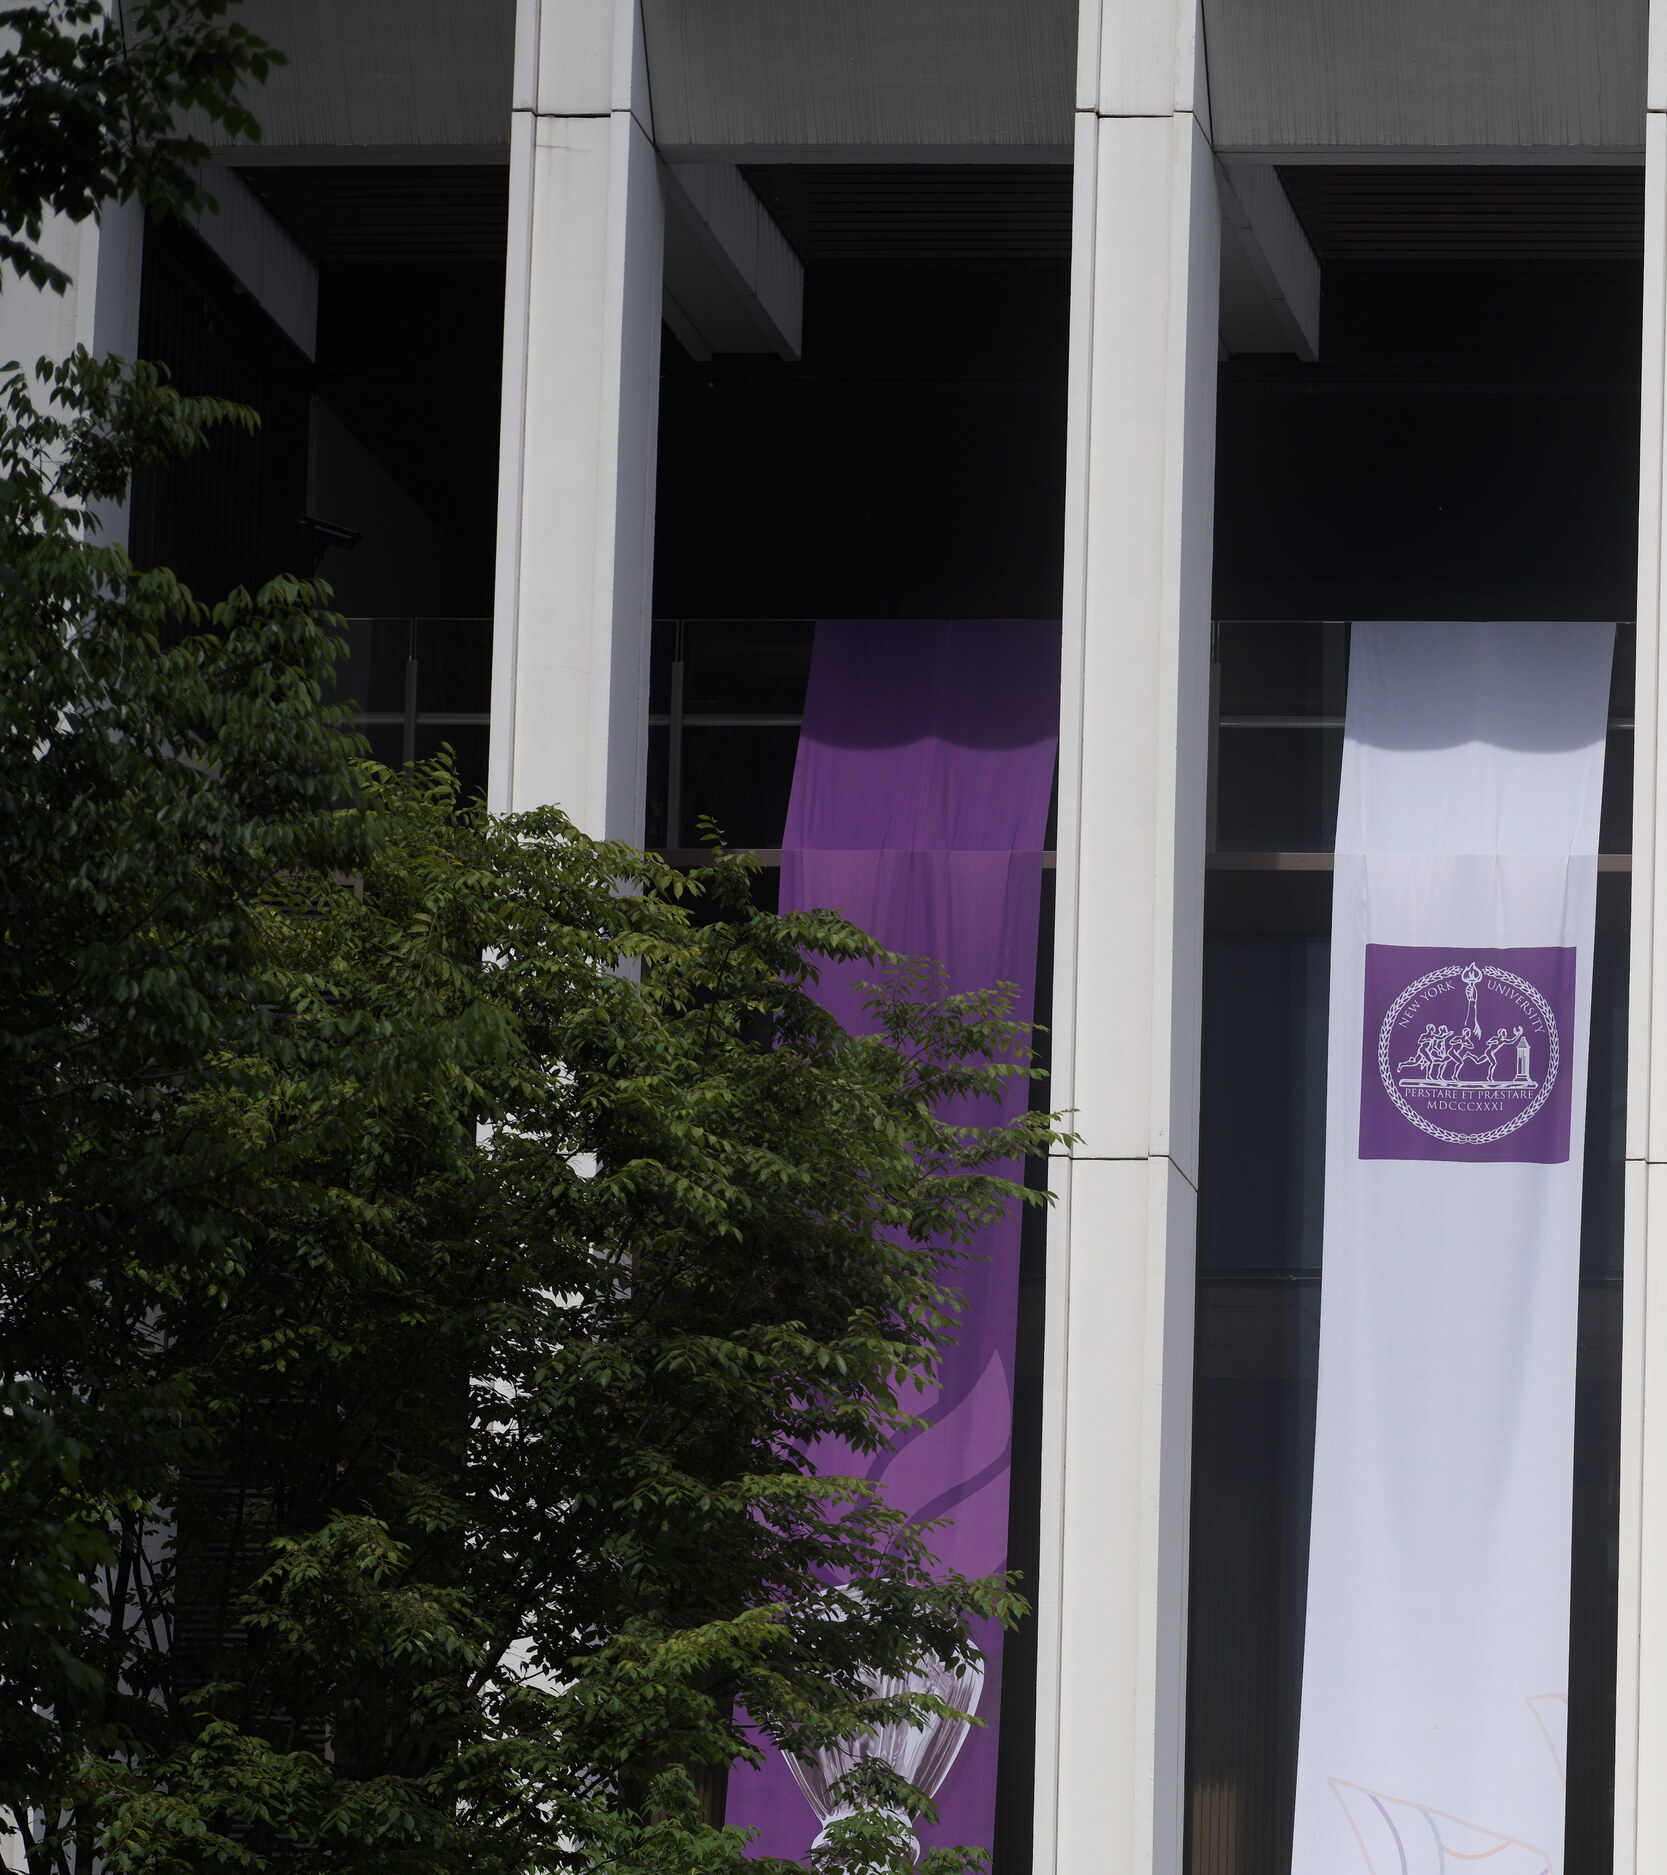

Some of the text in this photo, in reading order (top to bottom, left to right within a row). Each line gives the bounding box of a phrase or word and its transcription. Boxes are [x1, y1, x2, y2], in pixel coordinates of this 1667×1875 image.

[1398, 979, 1546, 1034] NEW YORK UNIVERSITY
[1405, 1087, 1458, 1100] PERSTARE
[1462, 1089, 1474, 1100] ET
[1426, 1100, 1504, 1112] MDCCCXXXI
